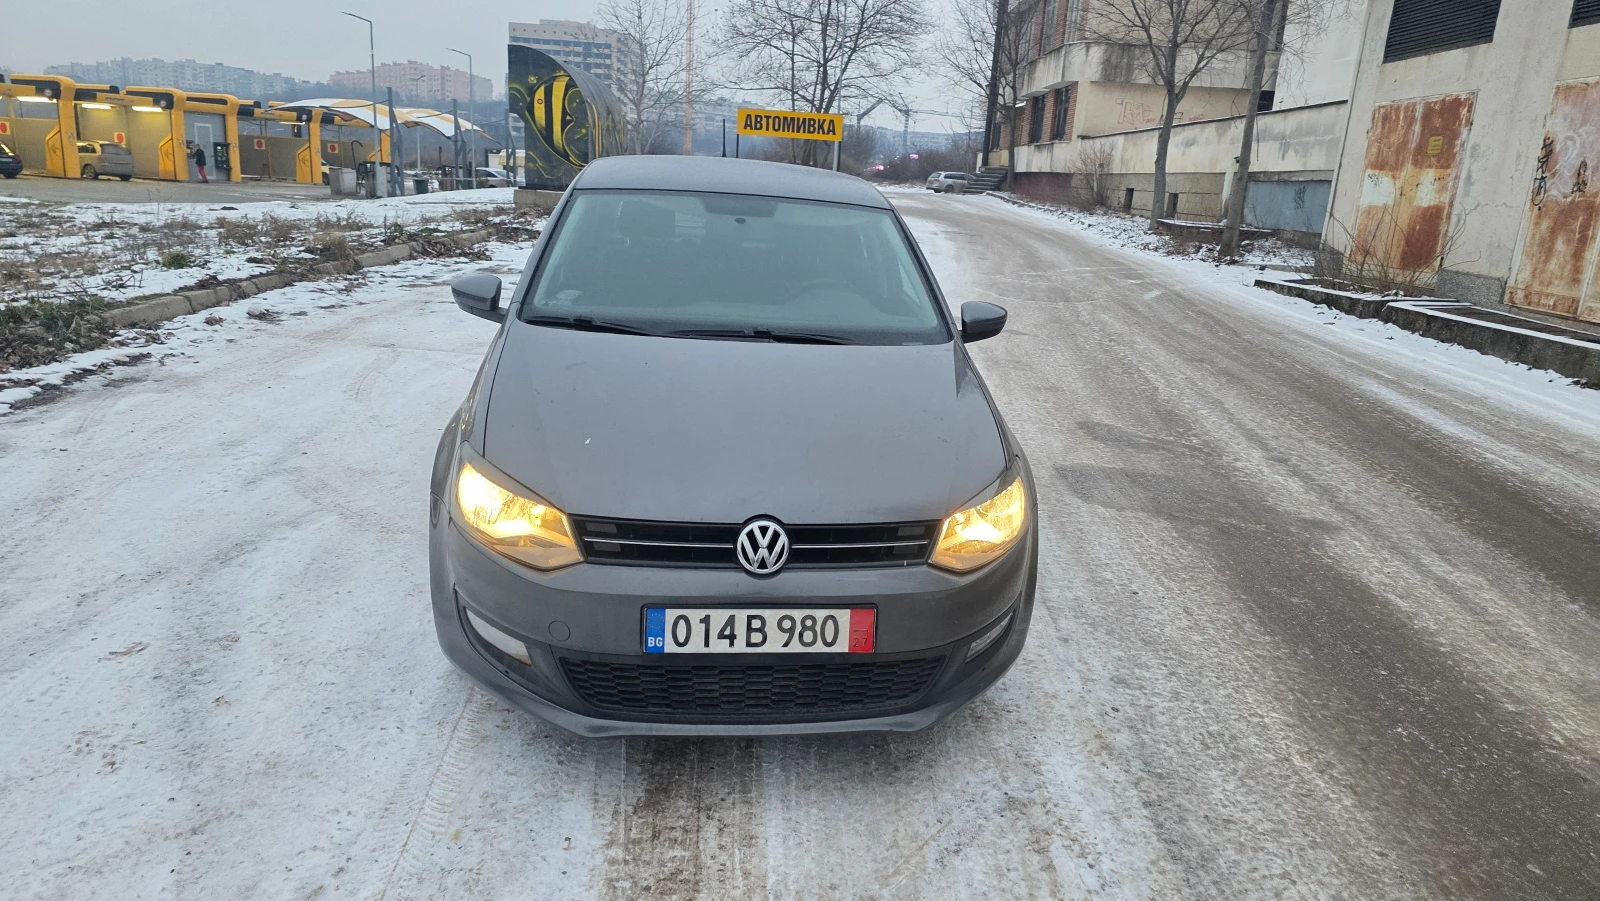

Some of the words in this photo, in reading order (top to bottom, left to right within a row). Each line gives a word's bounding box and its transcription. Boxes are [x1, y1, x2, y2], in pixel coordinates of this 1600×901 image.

[743, 113, 837, 136] АВТОМИВКА
[738, 521, 788, 573] VW
[647, 637, 663, 648] BG
[671, 614, 737, 648] 014
[745, 614, 768, 648] B
[777, 614, 840, 648] 980
[852, 637, 869, 649] 27
